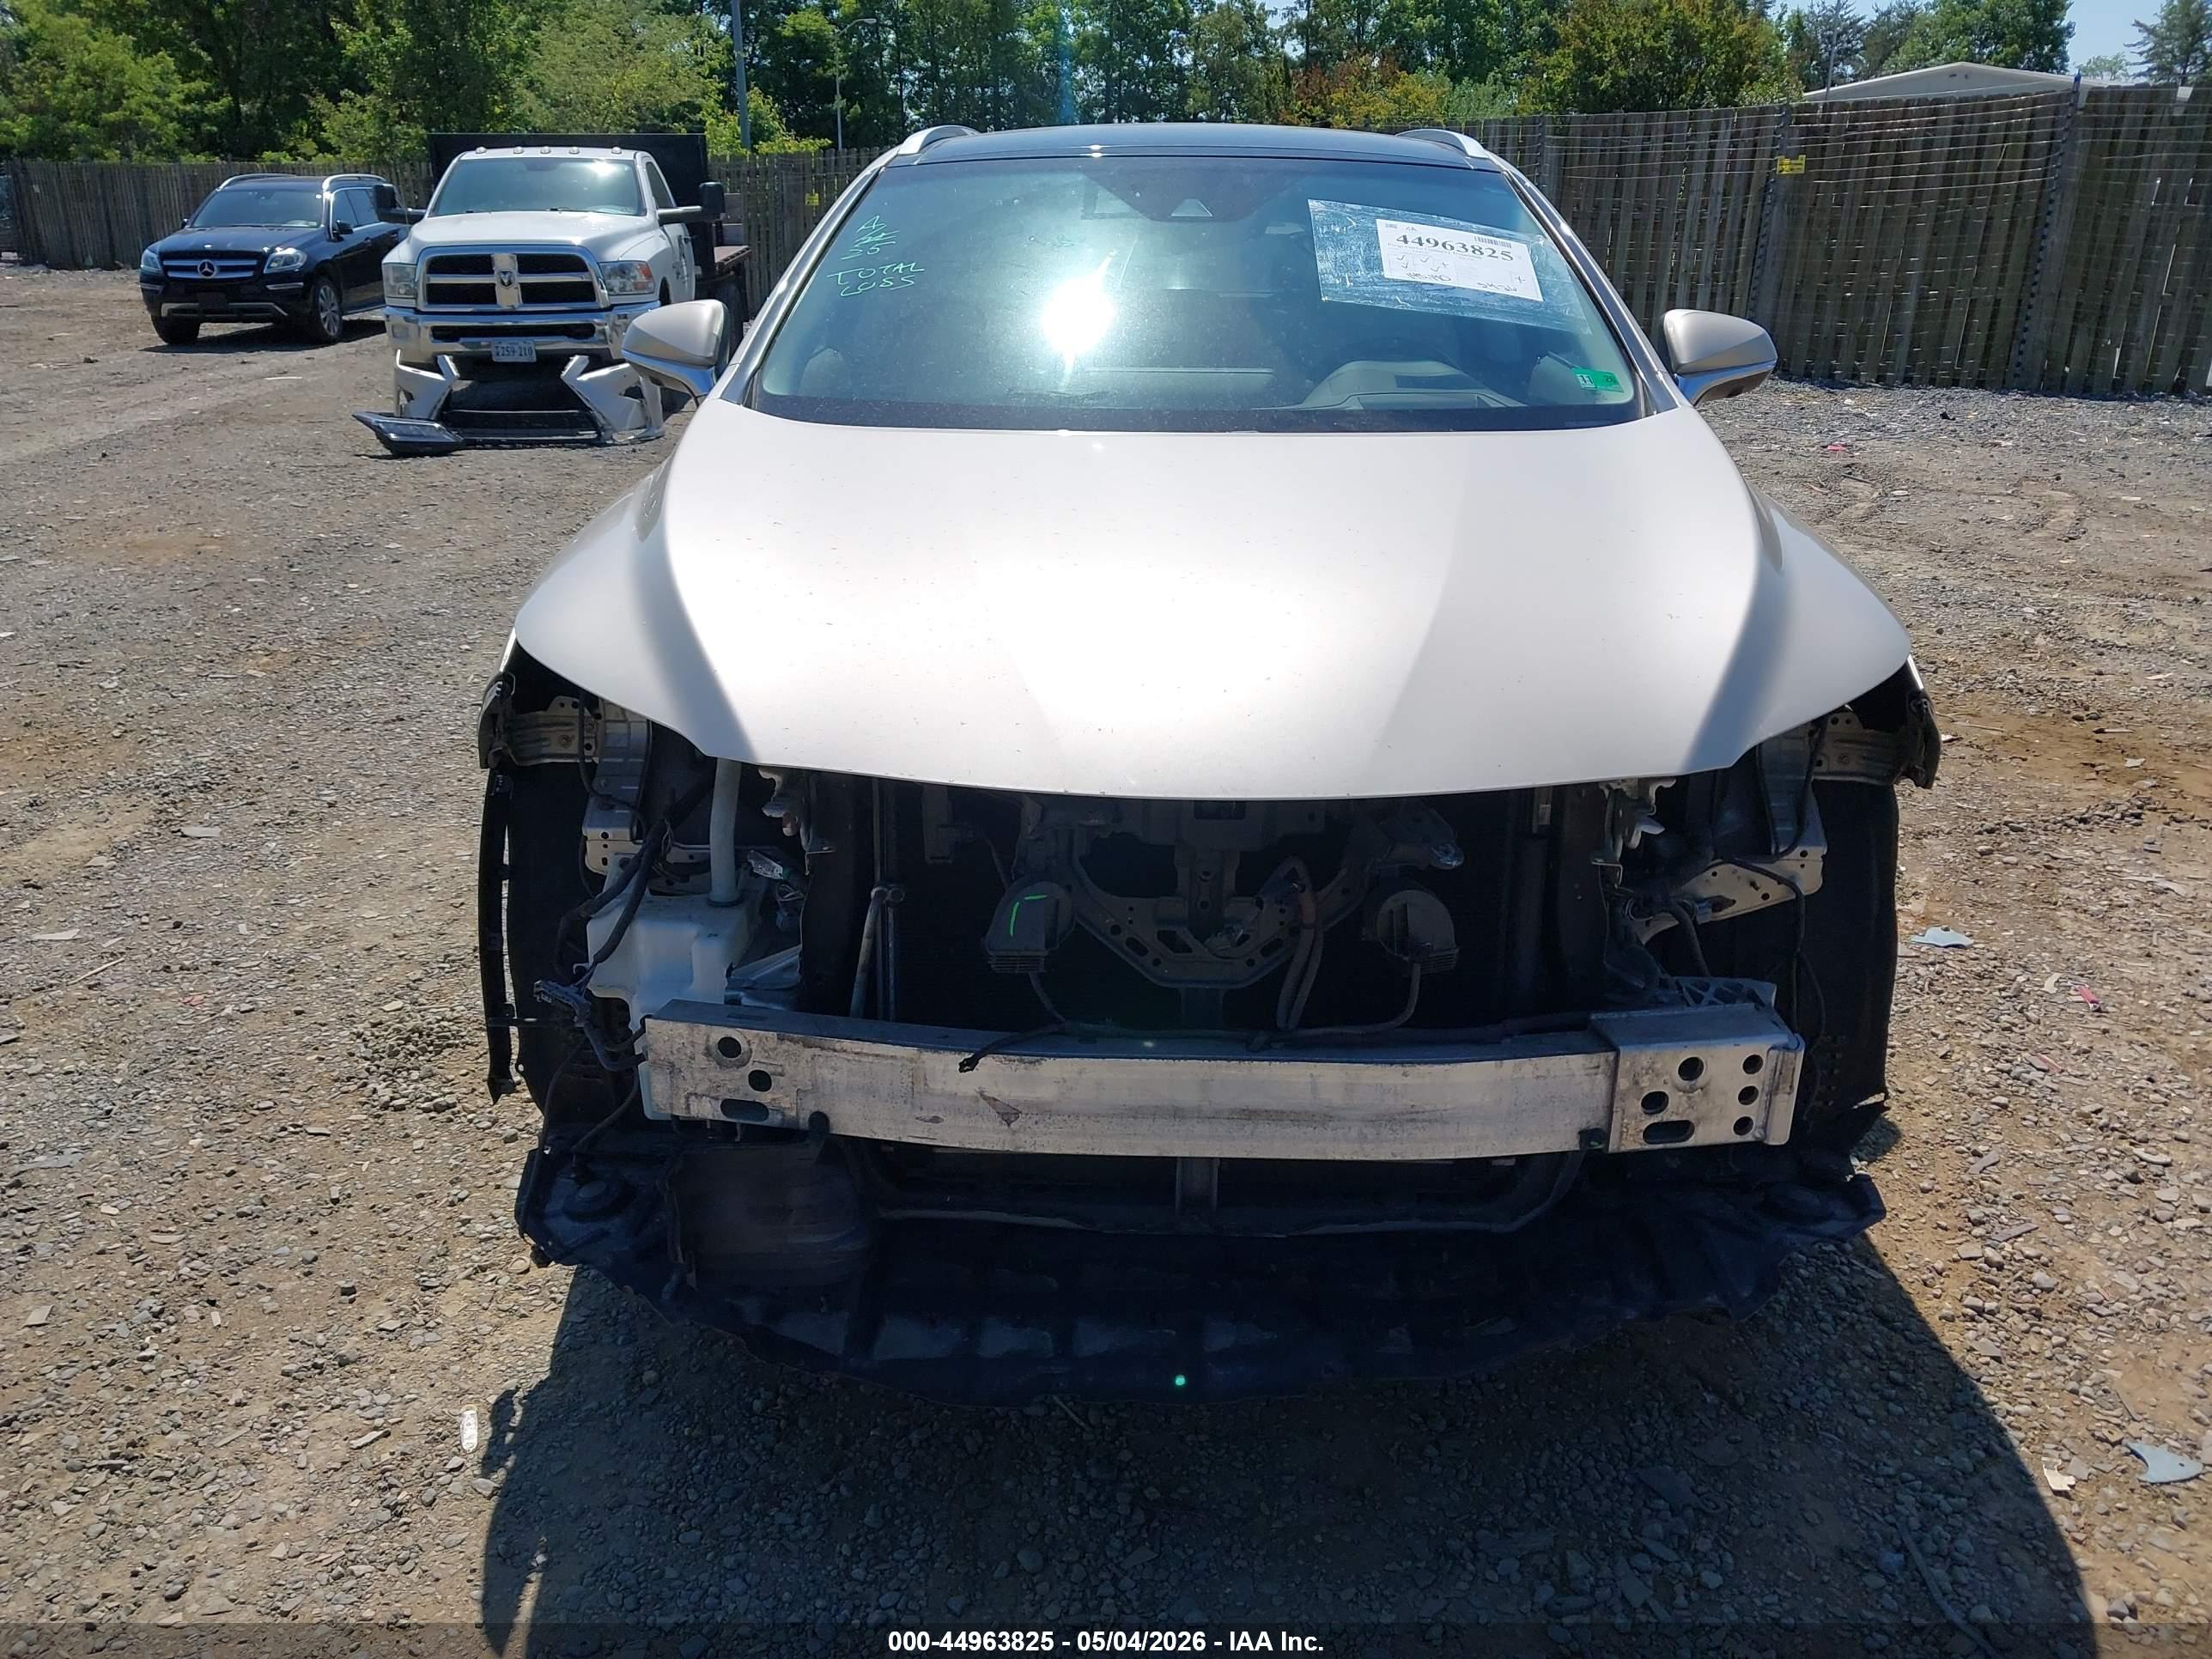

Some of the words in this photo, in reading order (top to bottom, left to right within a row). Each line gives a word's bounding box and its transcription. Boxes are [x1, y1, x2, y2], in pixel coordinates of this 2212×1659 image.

[1395, 234, 1514, 261] 44963825
[826, 262, 926, 285] TOTAL
[840, 275, 915, 297] LOSS
